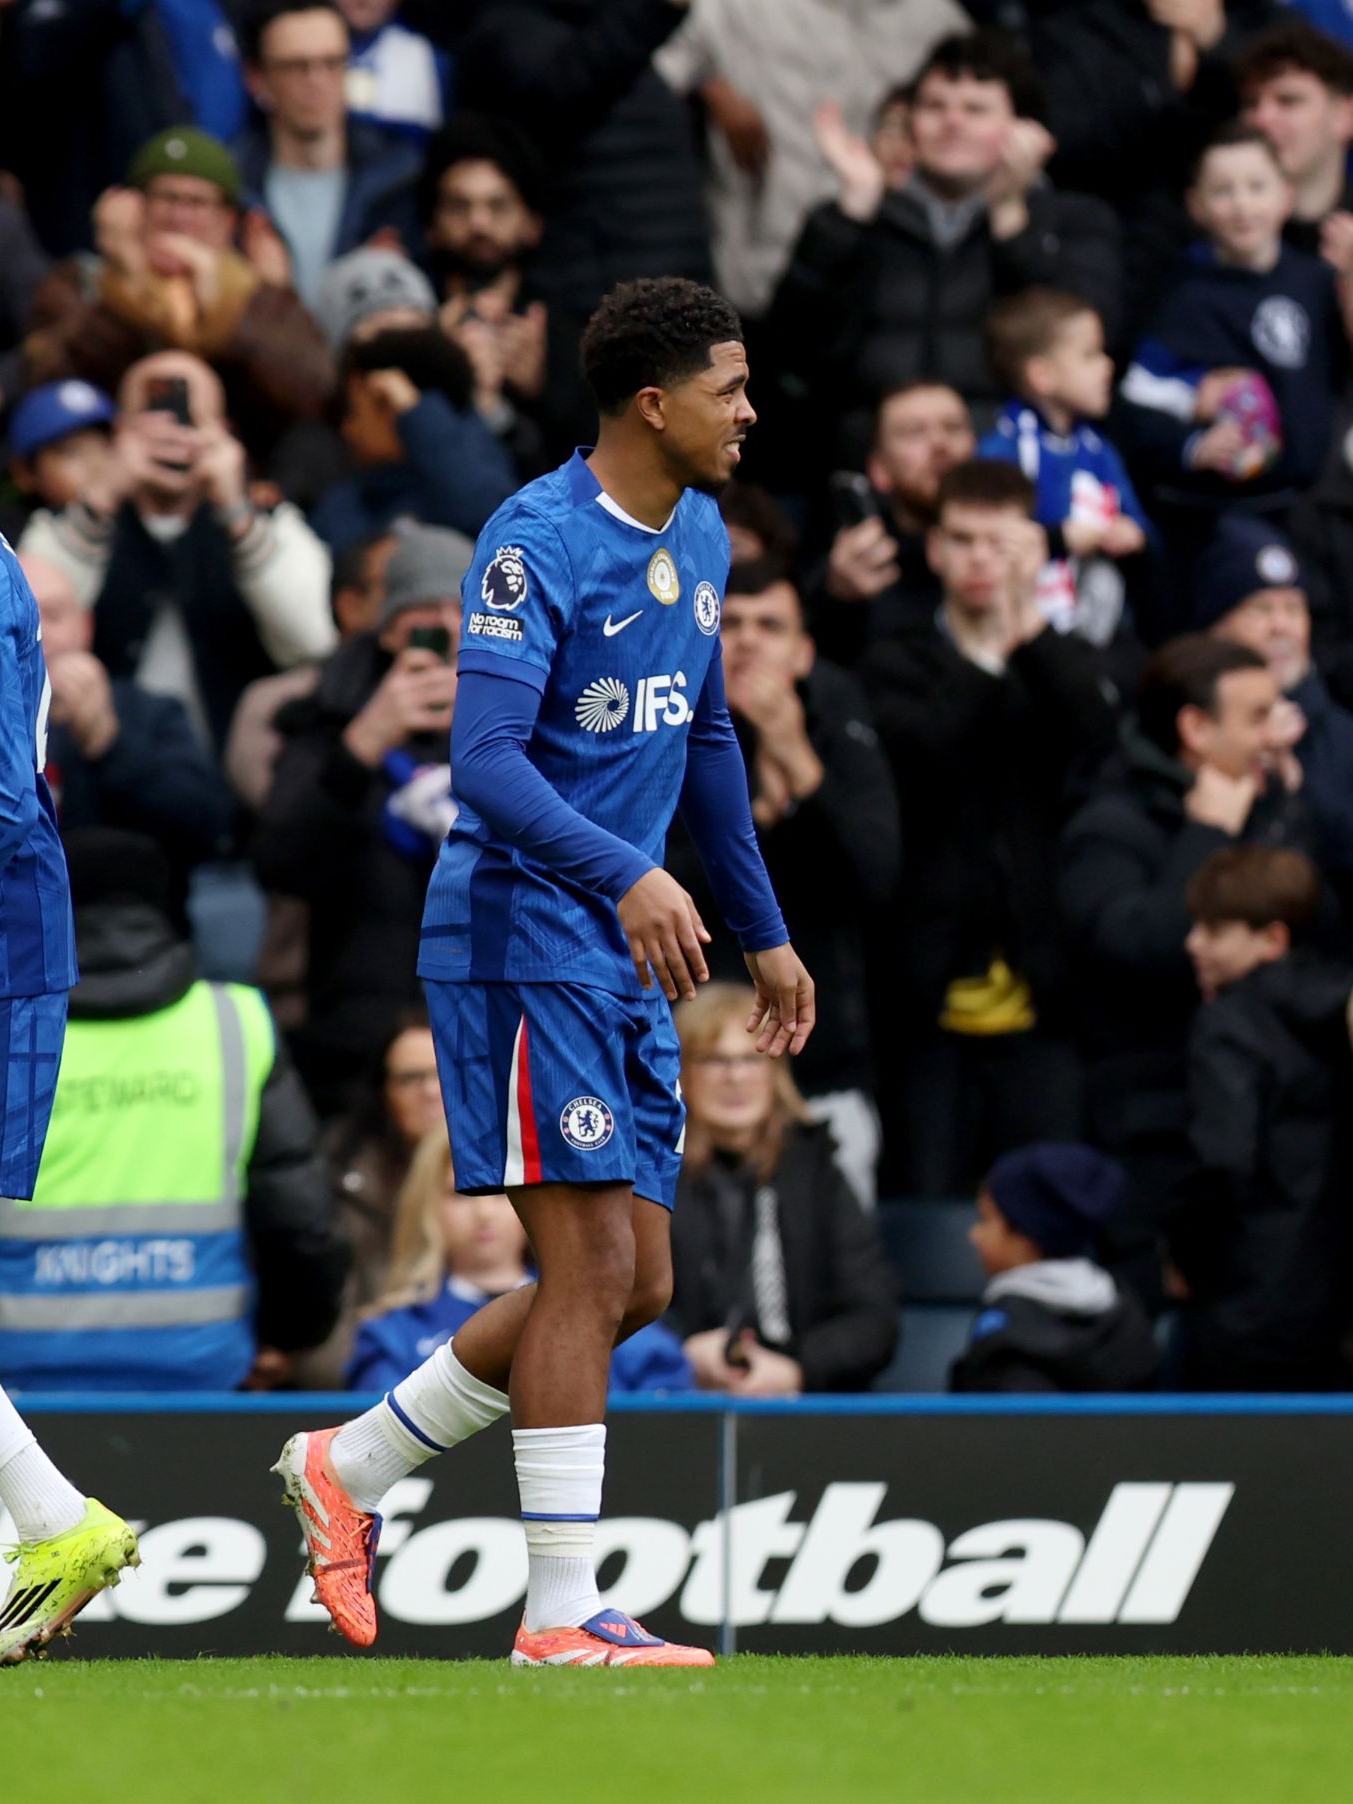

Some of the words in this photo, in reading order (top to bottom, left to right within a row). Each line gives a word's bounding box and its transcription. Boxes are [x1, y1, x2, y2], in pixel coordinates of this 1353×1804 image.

[469, 612, 485, 625] No
[485, 615, 519, 630] room
[482, 625, 523, 641] racism
[53, 1069, 201, 1114] TEWARD
[568, 1098, 602, 1111] CHELSEA
[35, 1239, 195, 1284] KNIGHTS
